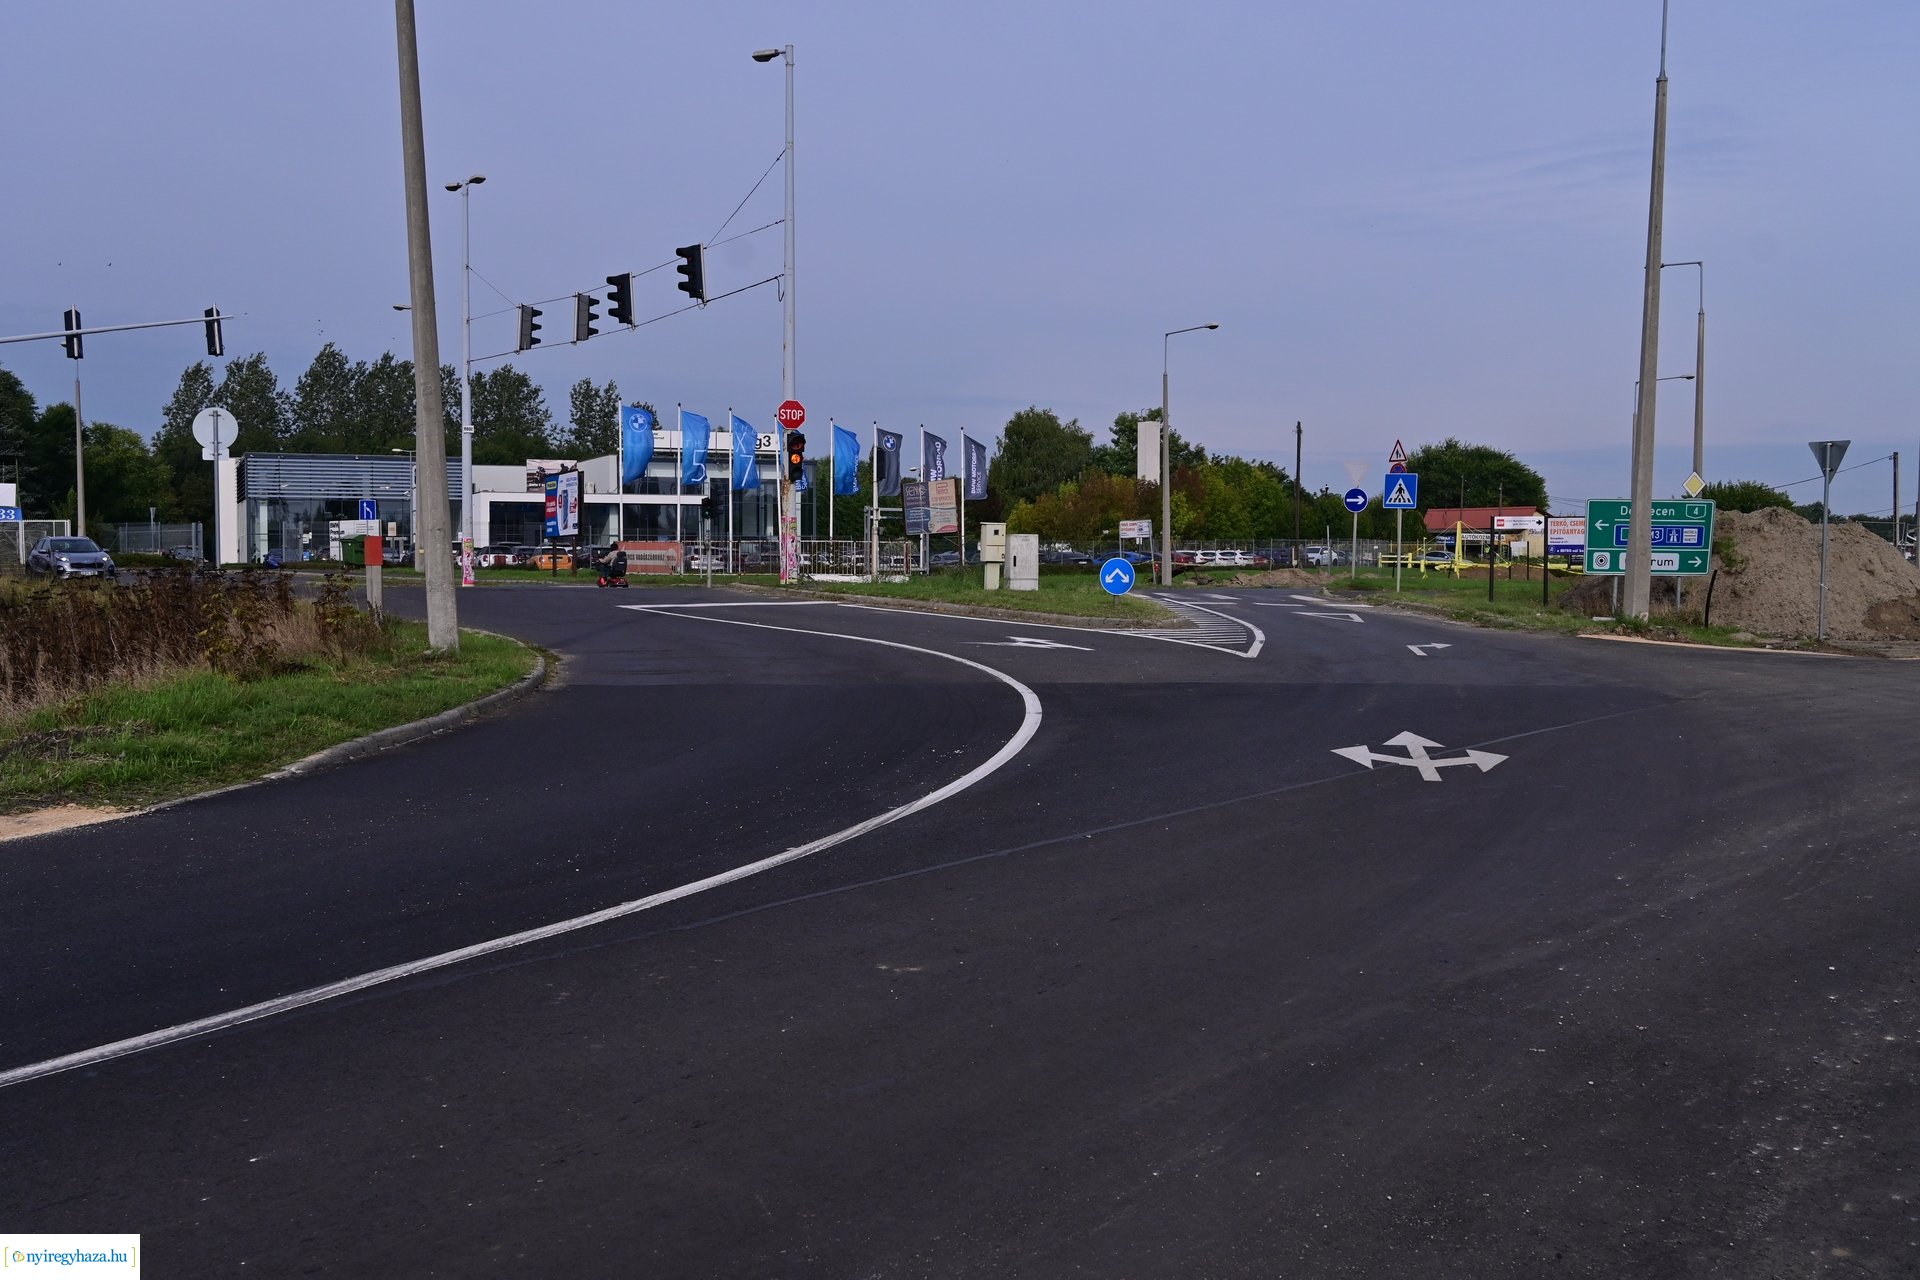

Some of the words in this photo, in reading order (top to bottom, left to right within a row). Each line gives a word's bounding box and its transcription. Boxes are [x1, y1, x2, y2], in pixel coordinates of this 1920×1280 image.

[780, 408, 804, 421] STOP
[691, 449, 706, 481] 5
[740, 454, 754, 487] 7
[1620, 506, 1675, 516] Deecen
[1693, 507, 1699, 515] 4
